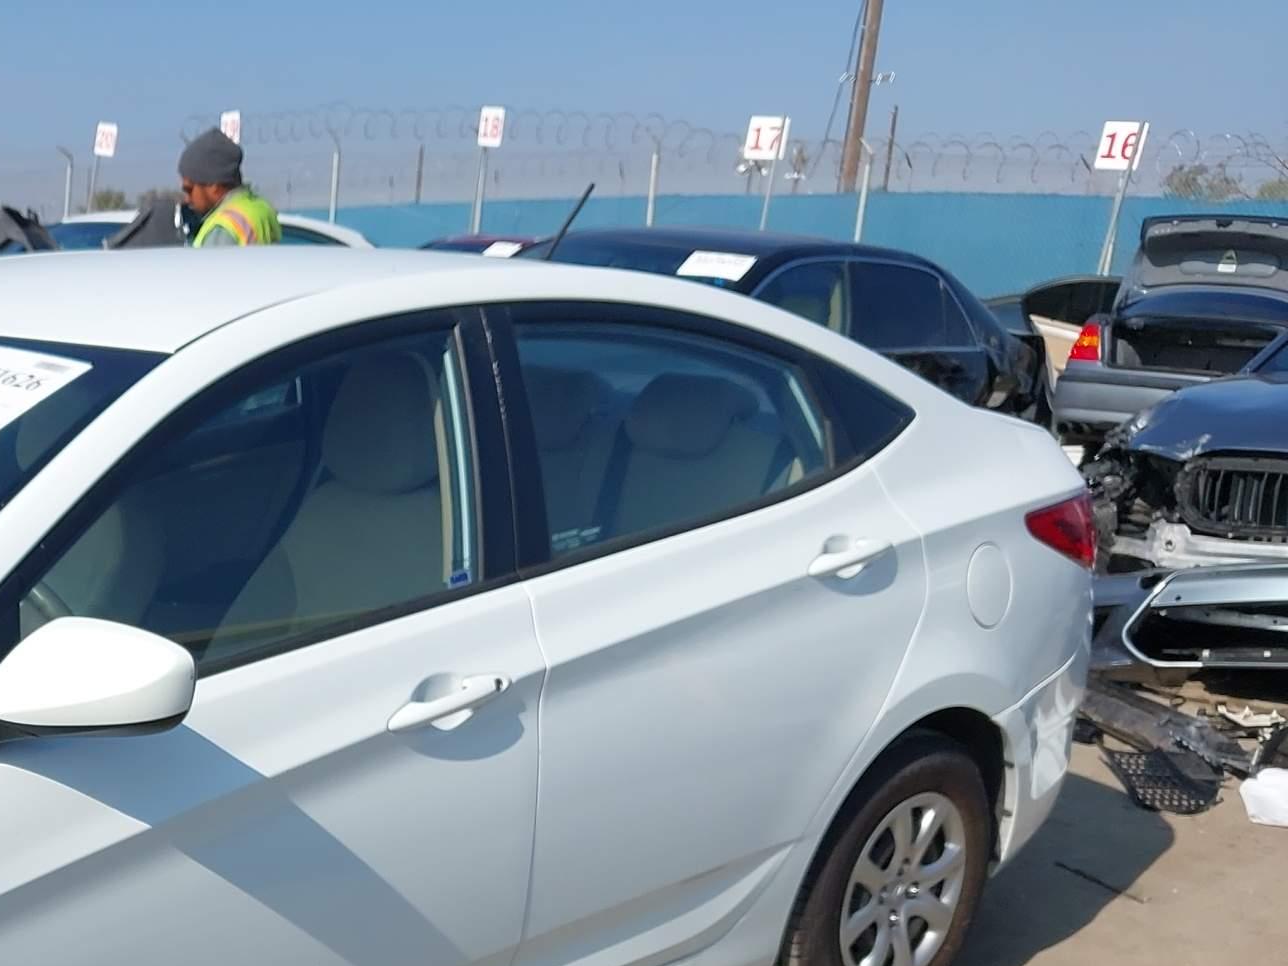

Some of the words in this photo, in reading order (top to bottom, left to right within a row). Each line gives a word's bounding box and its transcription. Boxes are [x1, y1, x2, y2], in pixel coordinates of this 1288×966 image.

[481, 115, 500, 138] 18
[749, 126, 781, 151] 17
[1100, 132, 1137, 160] 16
